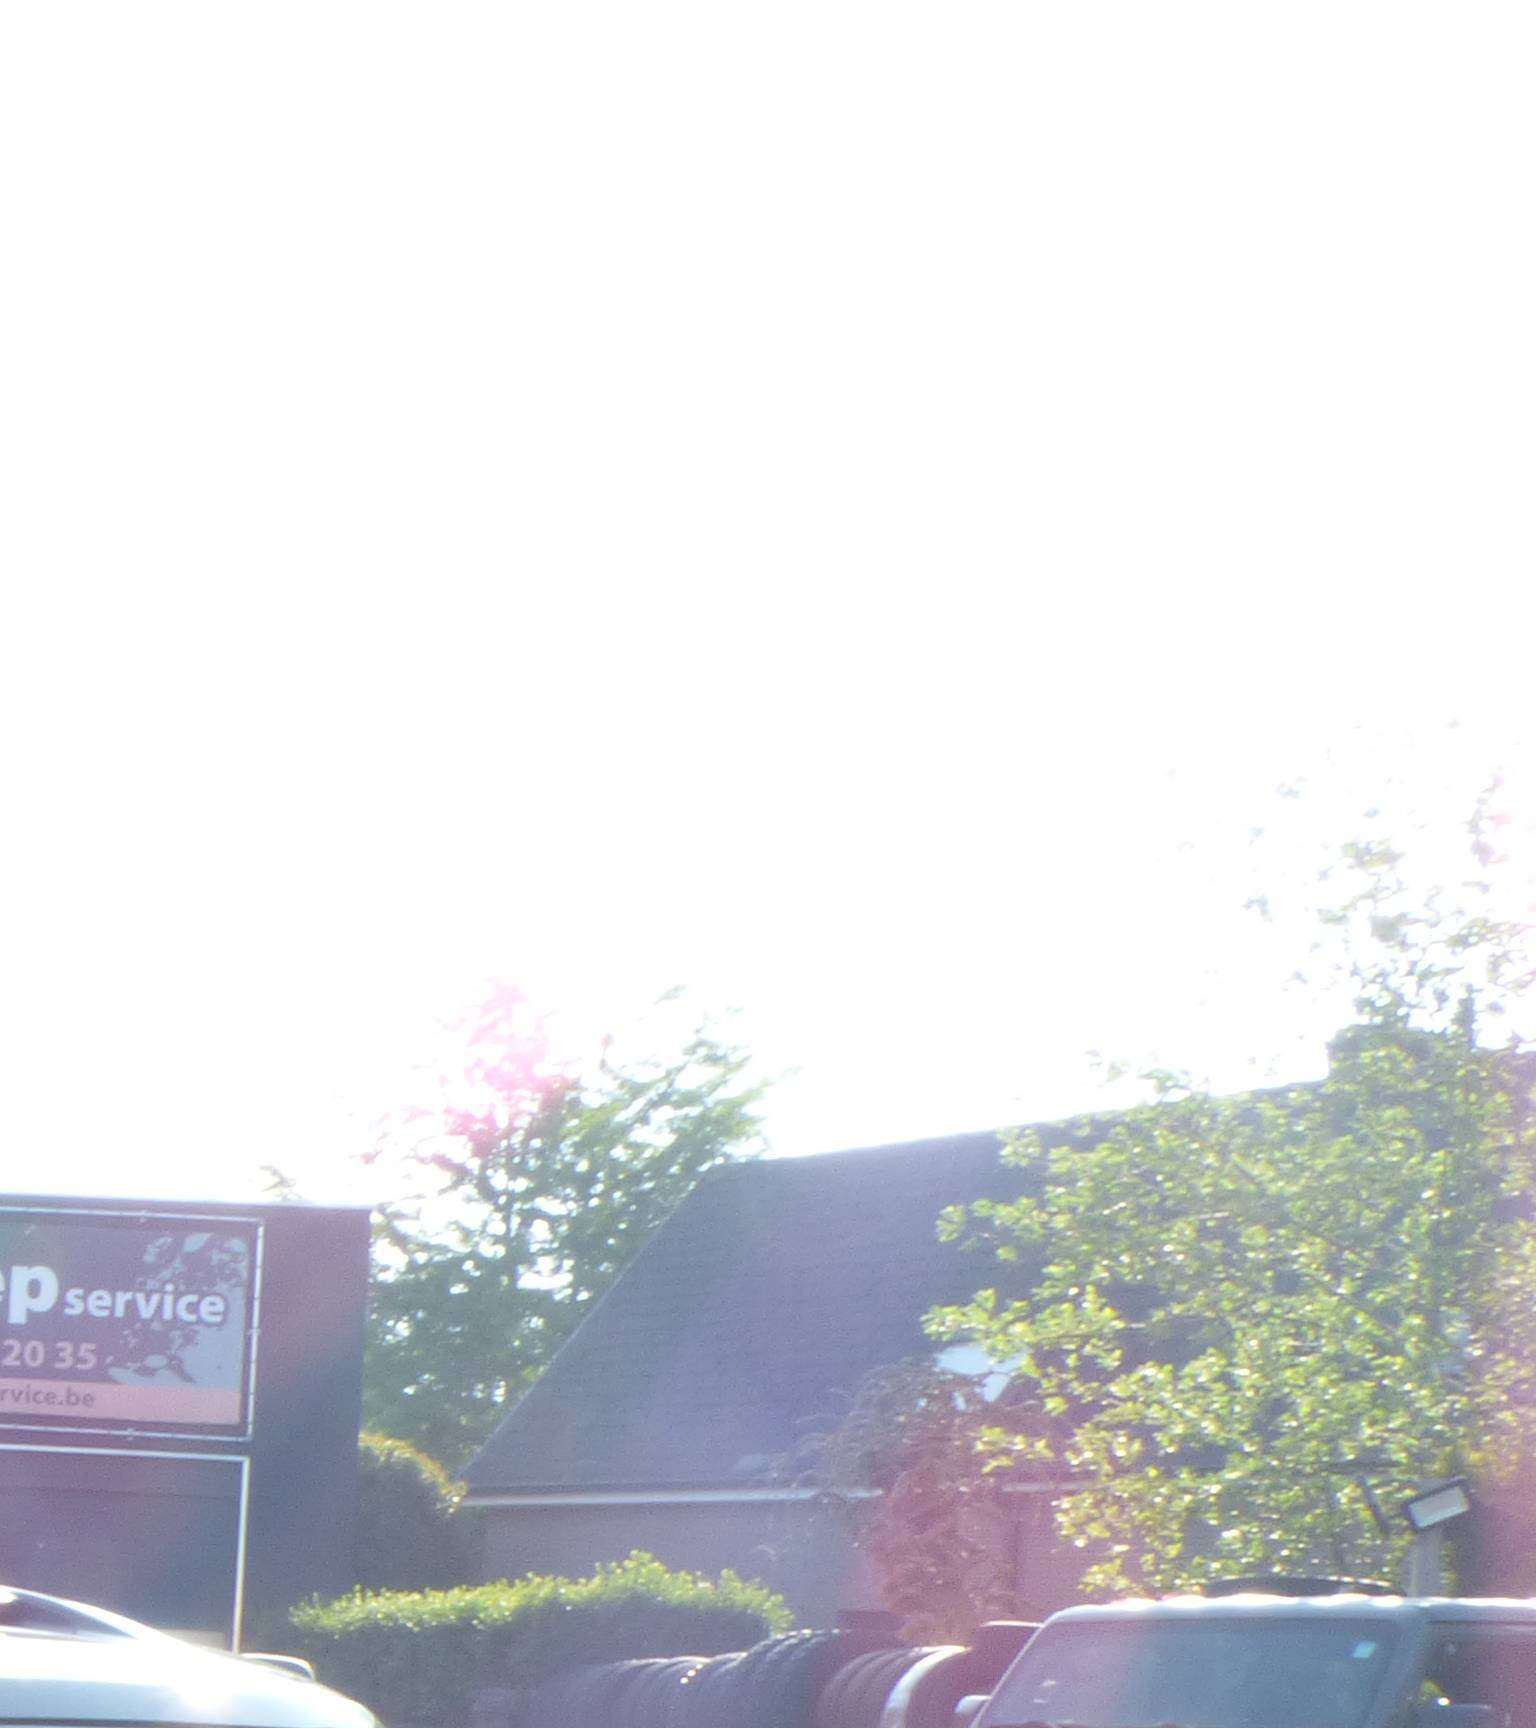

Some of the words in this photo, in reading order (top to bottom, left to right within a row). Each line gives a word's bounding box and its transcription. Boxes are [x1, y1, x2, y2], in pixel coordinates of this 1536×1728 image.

[64, 1283, 225, 1324] service
[1, 1338, 45, 1369] 20
[55, 1341, 98, 1371] 35
